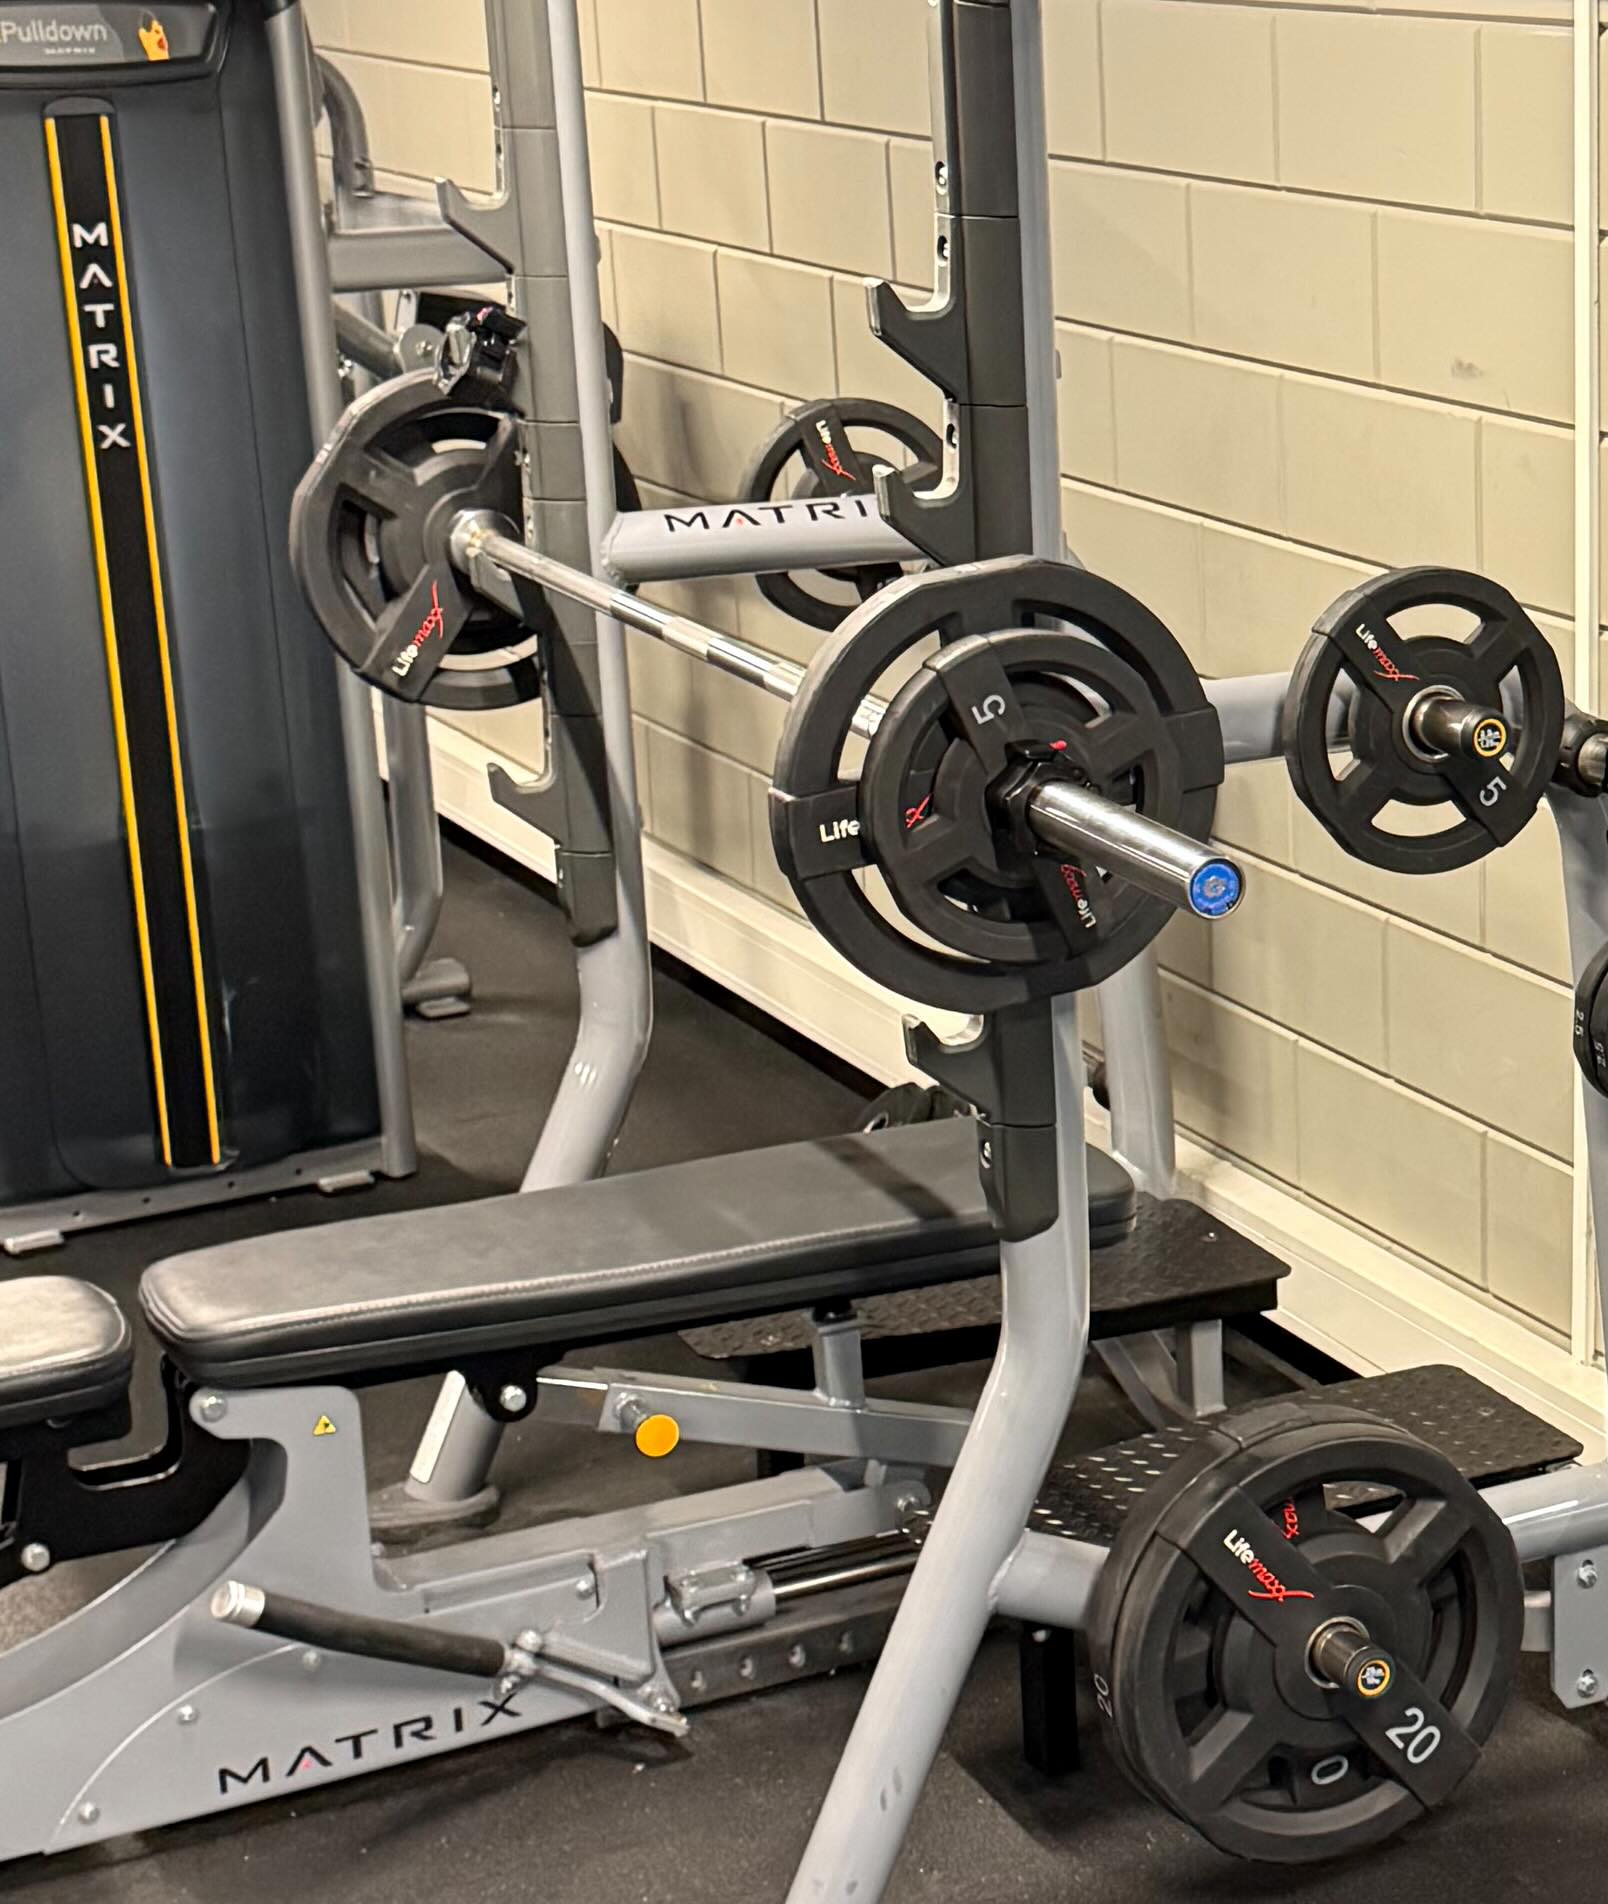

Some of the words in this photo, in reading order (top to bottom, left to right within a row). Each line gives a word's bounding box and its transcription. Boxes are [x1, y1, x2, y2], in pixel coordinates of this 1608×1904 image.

[1, 19, 107, 43] Pulldown
[72, 222, 130, 449] MATRIX
[663, 500, 868, 533] MATRI
[971, 694, 1007, 726] 5
[1479, 776, 1507, 807] 5
[819, 818, 861, 843] Life
[1223, 1529, 1315, 1602] Lifemaxx
[218, 1693, 523, 1796] MATRIX
[1385, 1707, 1441, 1764] 20
